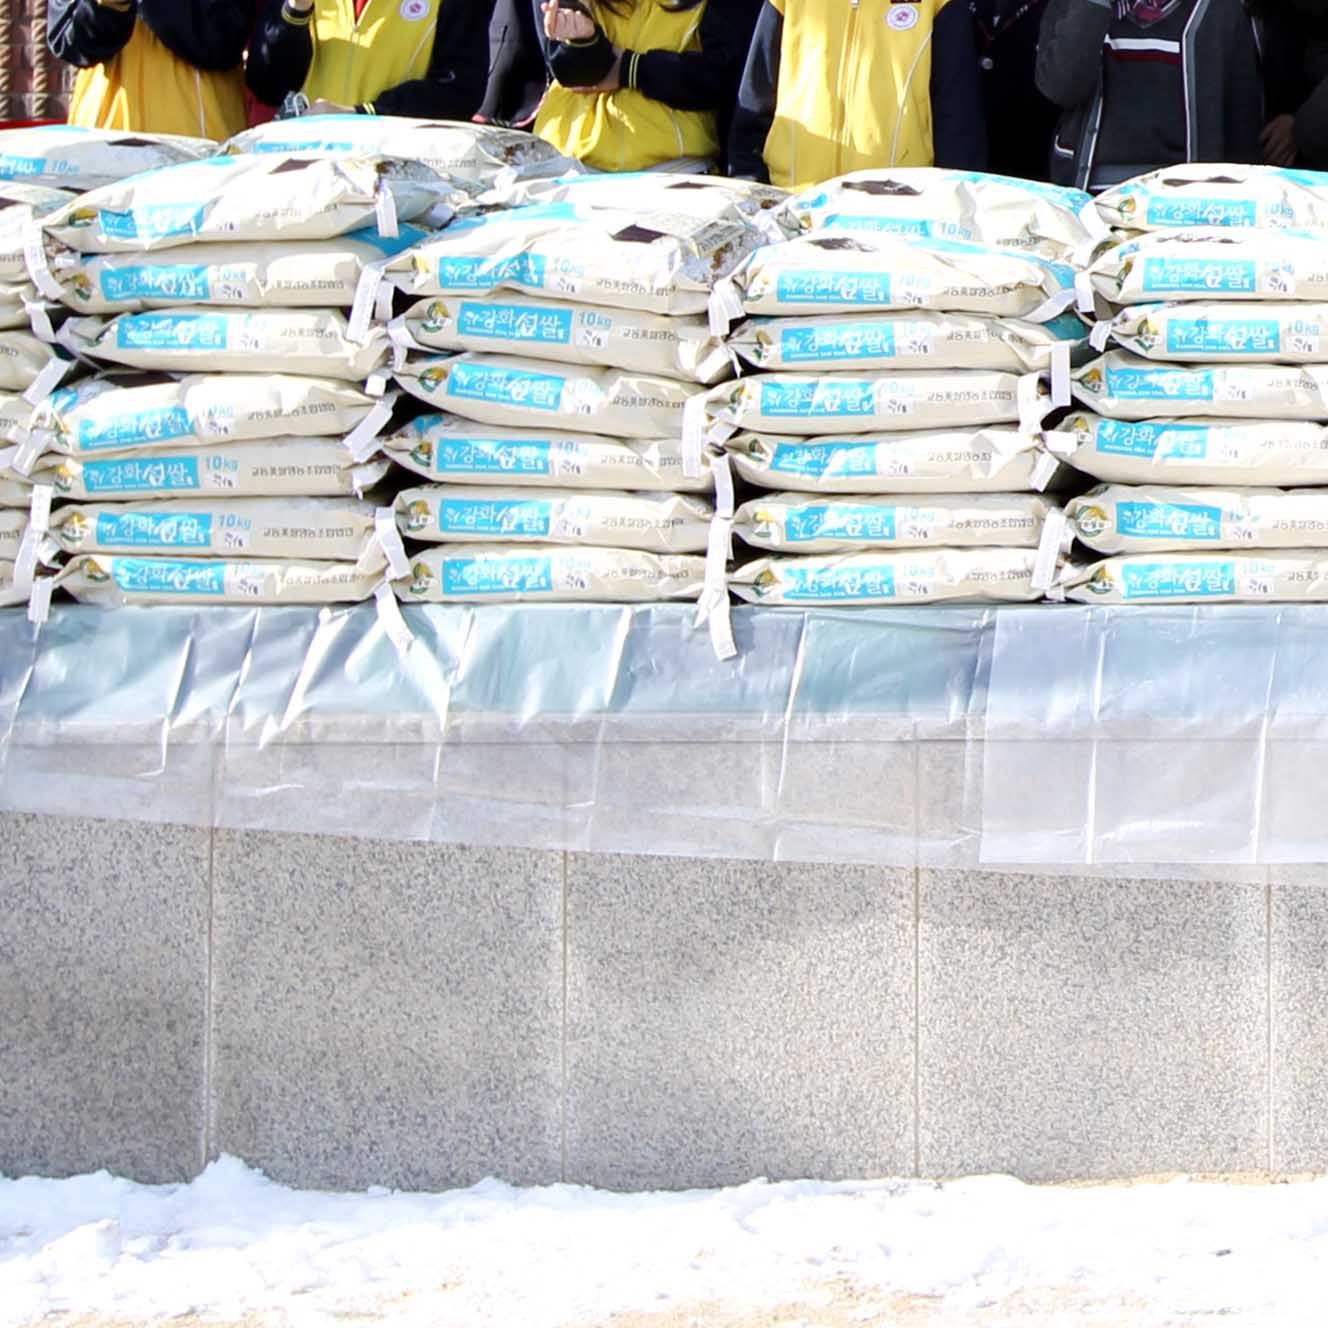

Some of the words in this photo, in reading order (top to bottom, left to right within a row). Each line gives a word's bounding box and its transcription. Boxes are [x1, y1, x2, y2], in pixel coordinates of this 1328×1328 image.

[579, 311, 613, 330] 10kg
[206, 456, 240, 473] 10kg
[220, 513, 251, 529] 10kg
